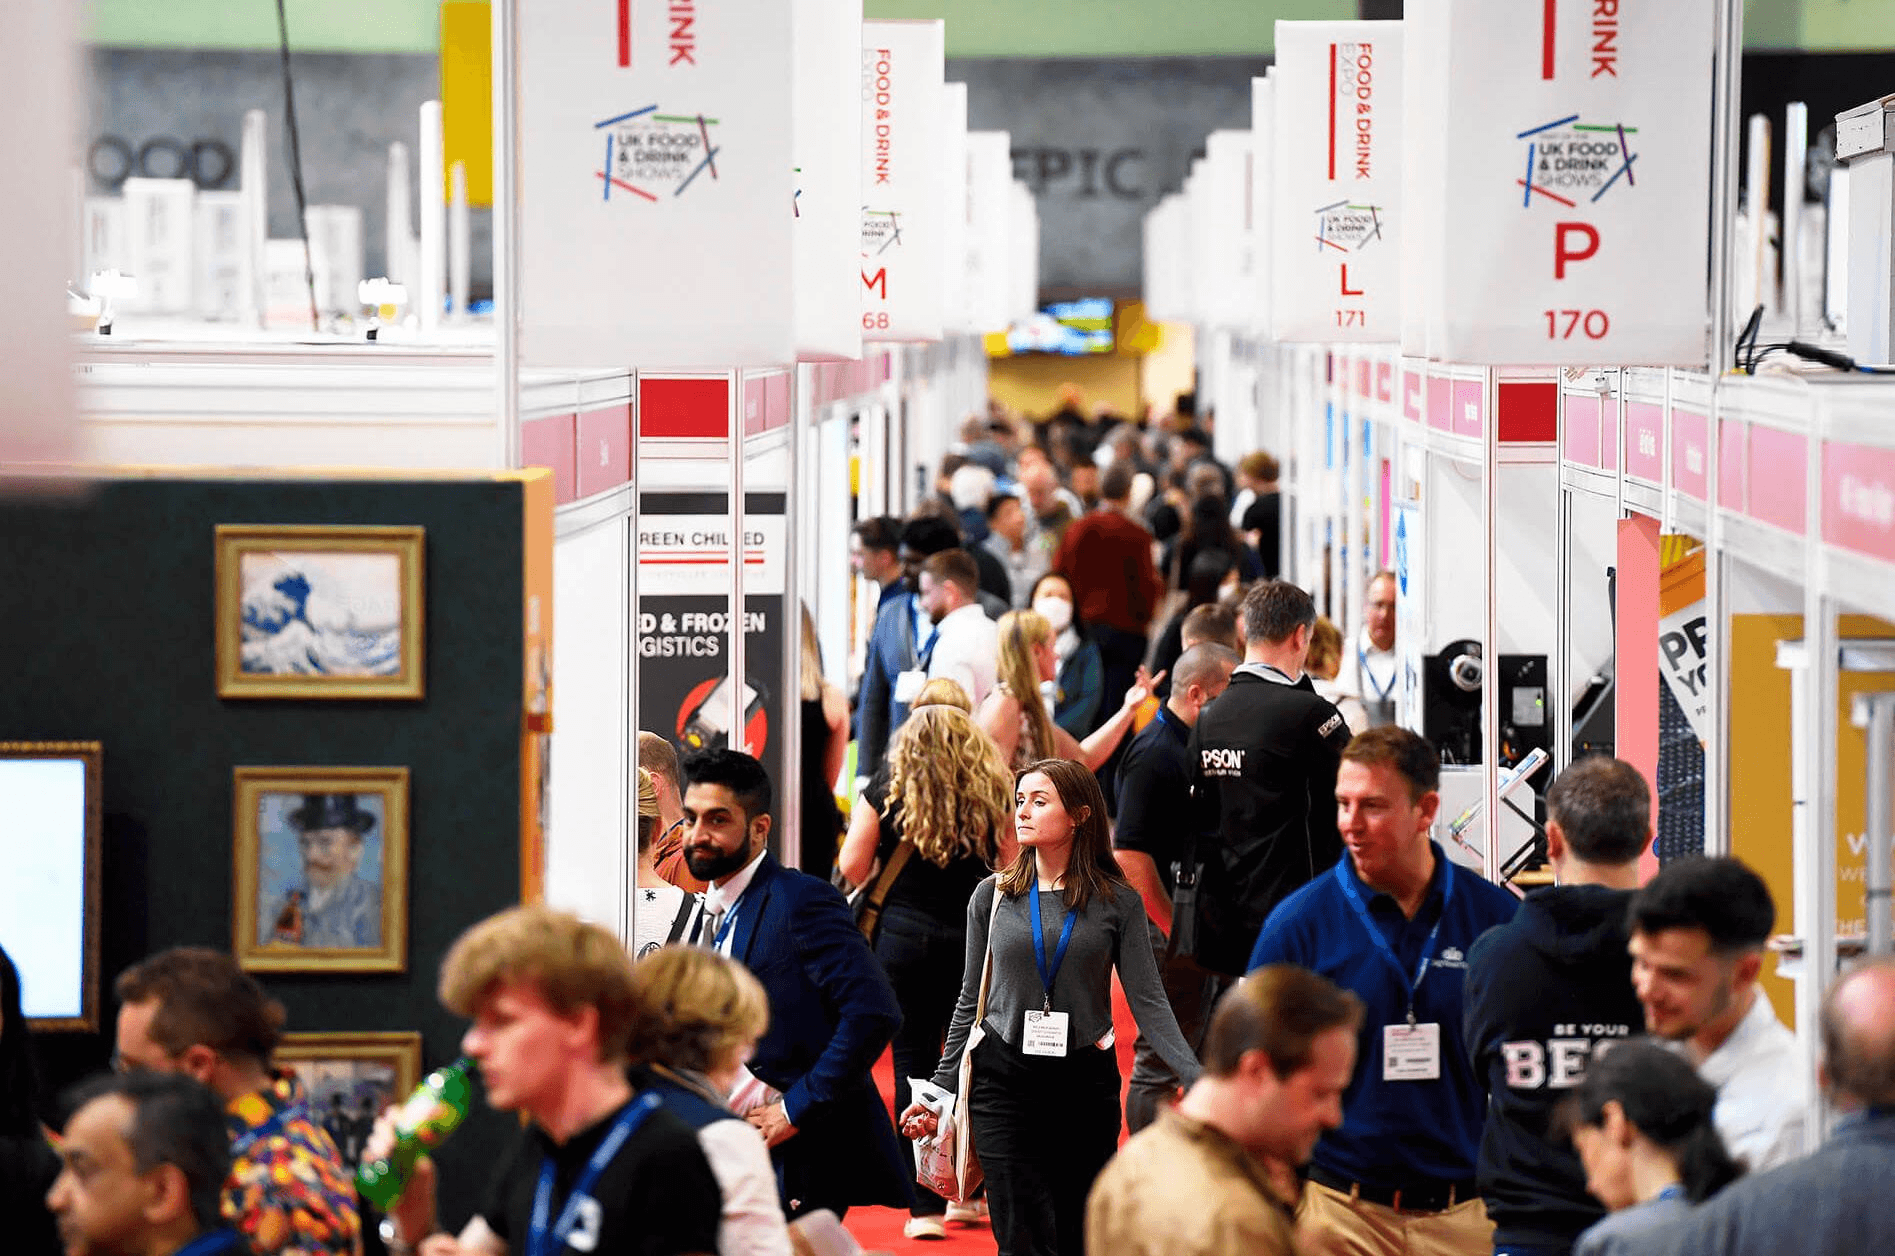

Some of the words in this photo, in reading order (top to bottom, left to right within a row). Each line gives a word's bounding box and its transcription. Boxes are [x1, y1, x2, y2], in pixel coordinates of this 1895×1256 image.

[668, 0, 695, 65] INK
[876, 49, 890, 105] FOOD
[1340, 43, 1355, 96] EXPO
[1357, 43, 1372, 99] FOOD
[876, 109, 889, 120] &
[1356, 103, 1371, 114] &
[648, 134, 700, 148] FOOD
[1356, 118, 1371, 179] DRINK
[1539, 143, 1562, 156] UK
[1568, 143, 1618, 156] FOOD
[635, 149, 690, 162] DRINK
[876, 125, 889, 184] DRINK
[1540, 159, 1550, 171] &
[1555, 158, 1608, 171] DRINK
[1555, 222, 1601, 280] P
[861, 266, 886, 300] M
[1341, 263, 1364, 295] L
[862, 312, 890, 330] 68
[1336, 310, 1365, 328] 171
[1544, 309, 1611, 340] 170
[640, 532, 684, 546] REEN
[691, 532, 765, 546] CHILED
[640, 613, 657, 634] D
[660, 613, 677, 634] &
[681, 612, 766, 634] FROEN
[639, 636, 720, 657] GISTICS
[1200, 748, 1241, 769] PSON
[1553, 1024, 1576, 1036] BE
[1581, 1024, 1629, 1036] YOUR
